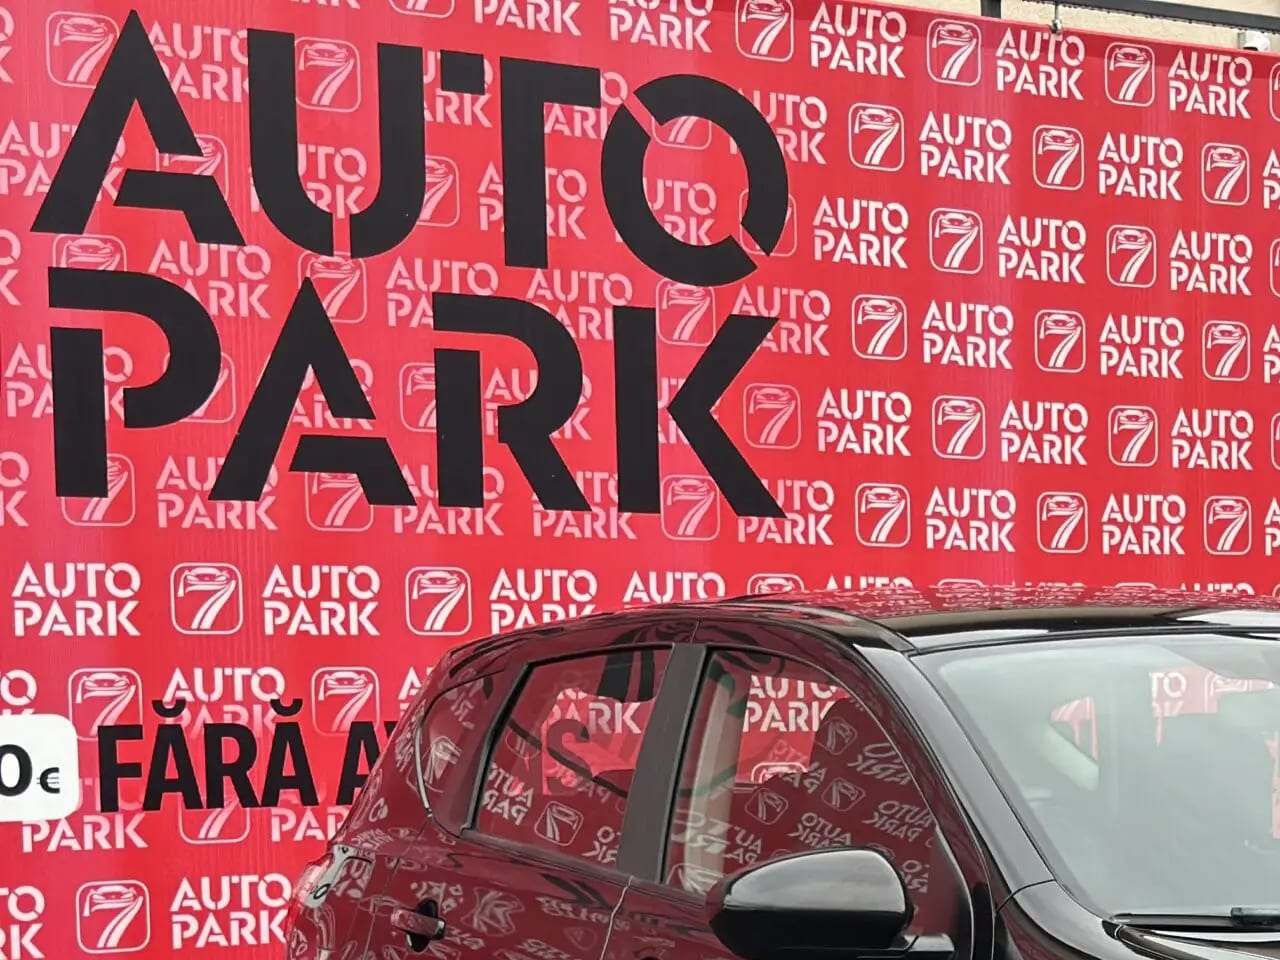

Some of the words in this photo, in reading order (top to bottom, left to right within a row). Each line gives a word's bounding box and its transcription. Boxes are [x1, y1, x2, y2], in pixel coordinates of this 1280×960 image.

[475, 0, 581, 35] PARK
[610, 7, 711, 52] PARK
[810, 3, 906, 45] AUTO
[811, 35, 904, 77] PARK
[996, 28, 1084, 66] AUTO
[997, 60, 1083, 100] PARK
[1168, 51, 1252, 87] AUTO
[1169, 80, 1250, 118] PARK
[30, 9, 788, 287] AUTO
[920, 112, 1011, 152] AUTO
[921, 144, 1010, 184] PARK
[1098, 132, 1183, 169] AUTO
[1099, 164, 1182, 200] PARK
[814, 196, 908, 235] AUTO
[998, 215, 1086, 250] AUTO
[815, 230, 907, 268] PARK
[1170, 230, 1252, 263] AUTO
[999, 247, 1084, 283] PARK
[1171, 261, 1251, 295] PARK
[526, 269, 632, 305] AUTO
[732, 285, 830, 317] AUTO
[922, 301, 1013, 336] AUTO
[1100, 315, 1184, 347] AUTO
[924, 333, 1012, 369] PARK
[1101, 345, 1183, 378] PARK
[48, 267, 788, 519] PARK
[817, 389, 911, 422] AUTO
[1000, 400, 1088, 433] AUTO
[1171, 408, 1253, 439] AUTO
[819, 421, 910, 456] PARK
[1001, 432, 1086, 465] PARK
[1172, 439, 1252, 470] PARK
[158, 493, 277, 530] PARK
[925, 487, 1016, 519] AUTO
[1102, 494, 1185, 524] AUTO
[739, 513, 833, 545] PARK
[927, 519, 1015, 552] PARK
[1103, 525, 1184, 554] PARK
[12, 562, 140, 597] AUTO
[262, 565, 380, 599] AUTO
[490, 569, 597, 602] AUTO
[623, 571, 725, 604] AUTO
[15, 600, 139, 636] PARK
[264, 601, 379, 635] PARK
[163, 667, 285, 702] AUTO
[98, 698, 320, 813] FĂRĂ
[23, 815, 147, 852] PARK
[171, 873, 291, 911] AUTO
[172, 909, 288, 949] PARK
